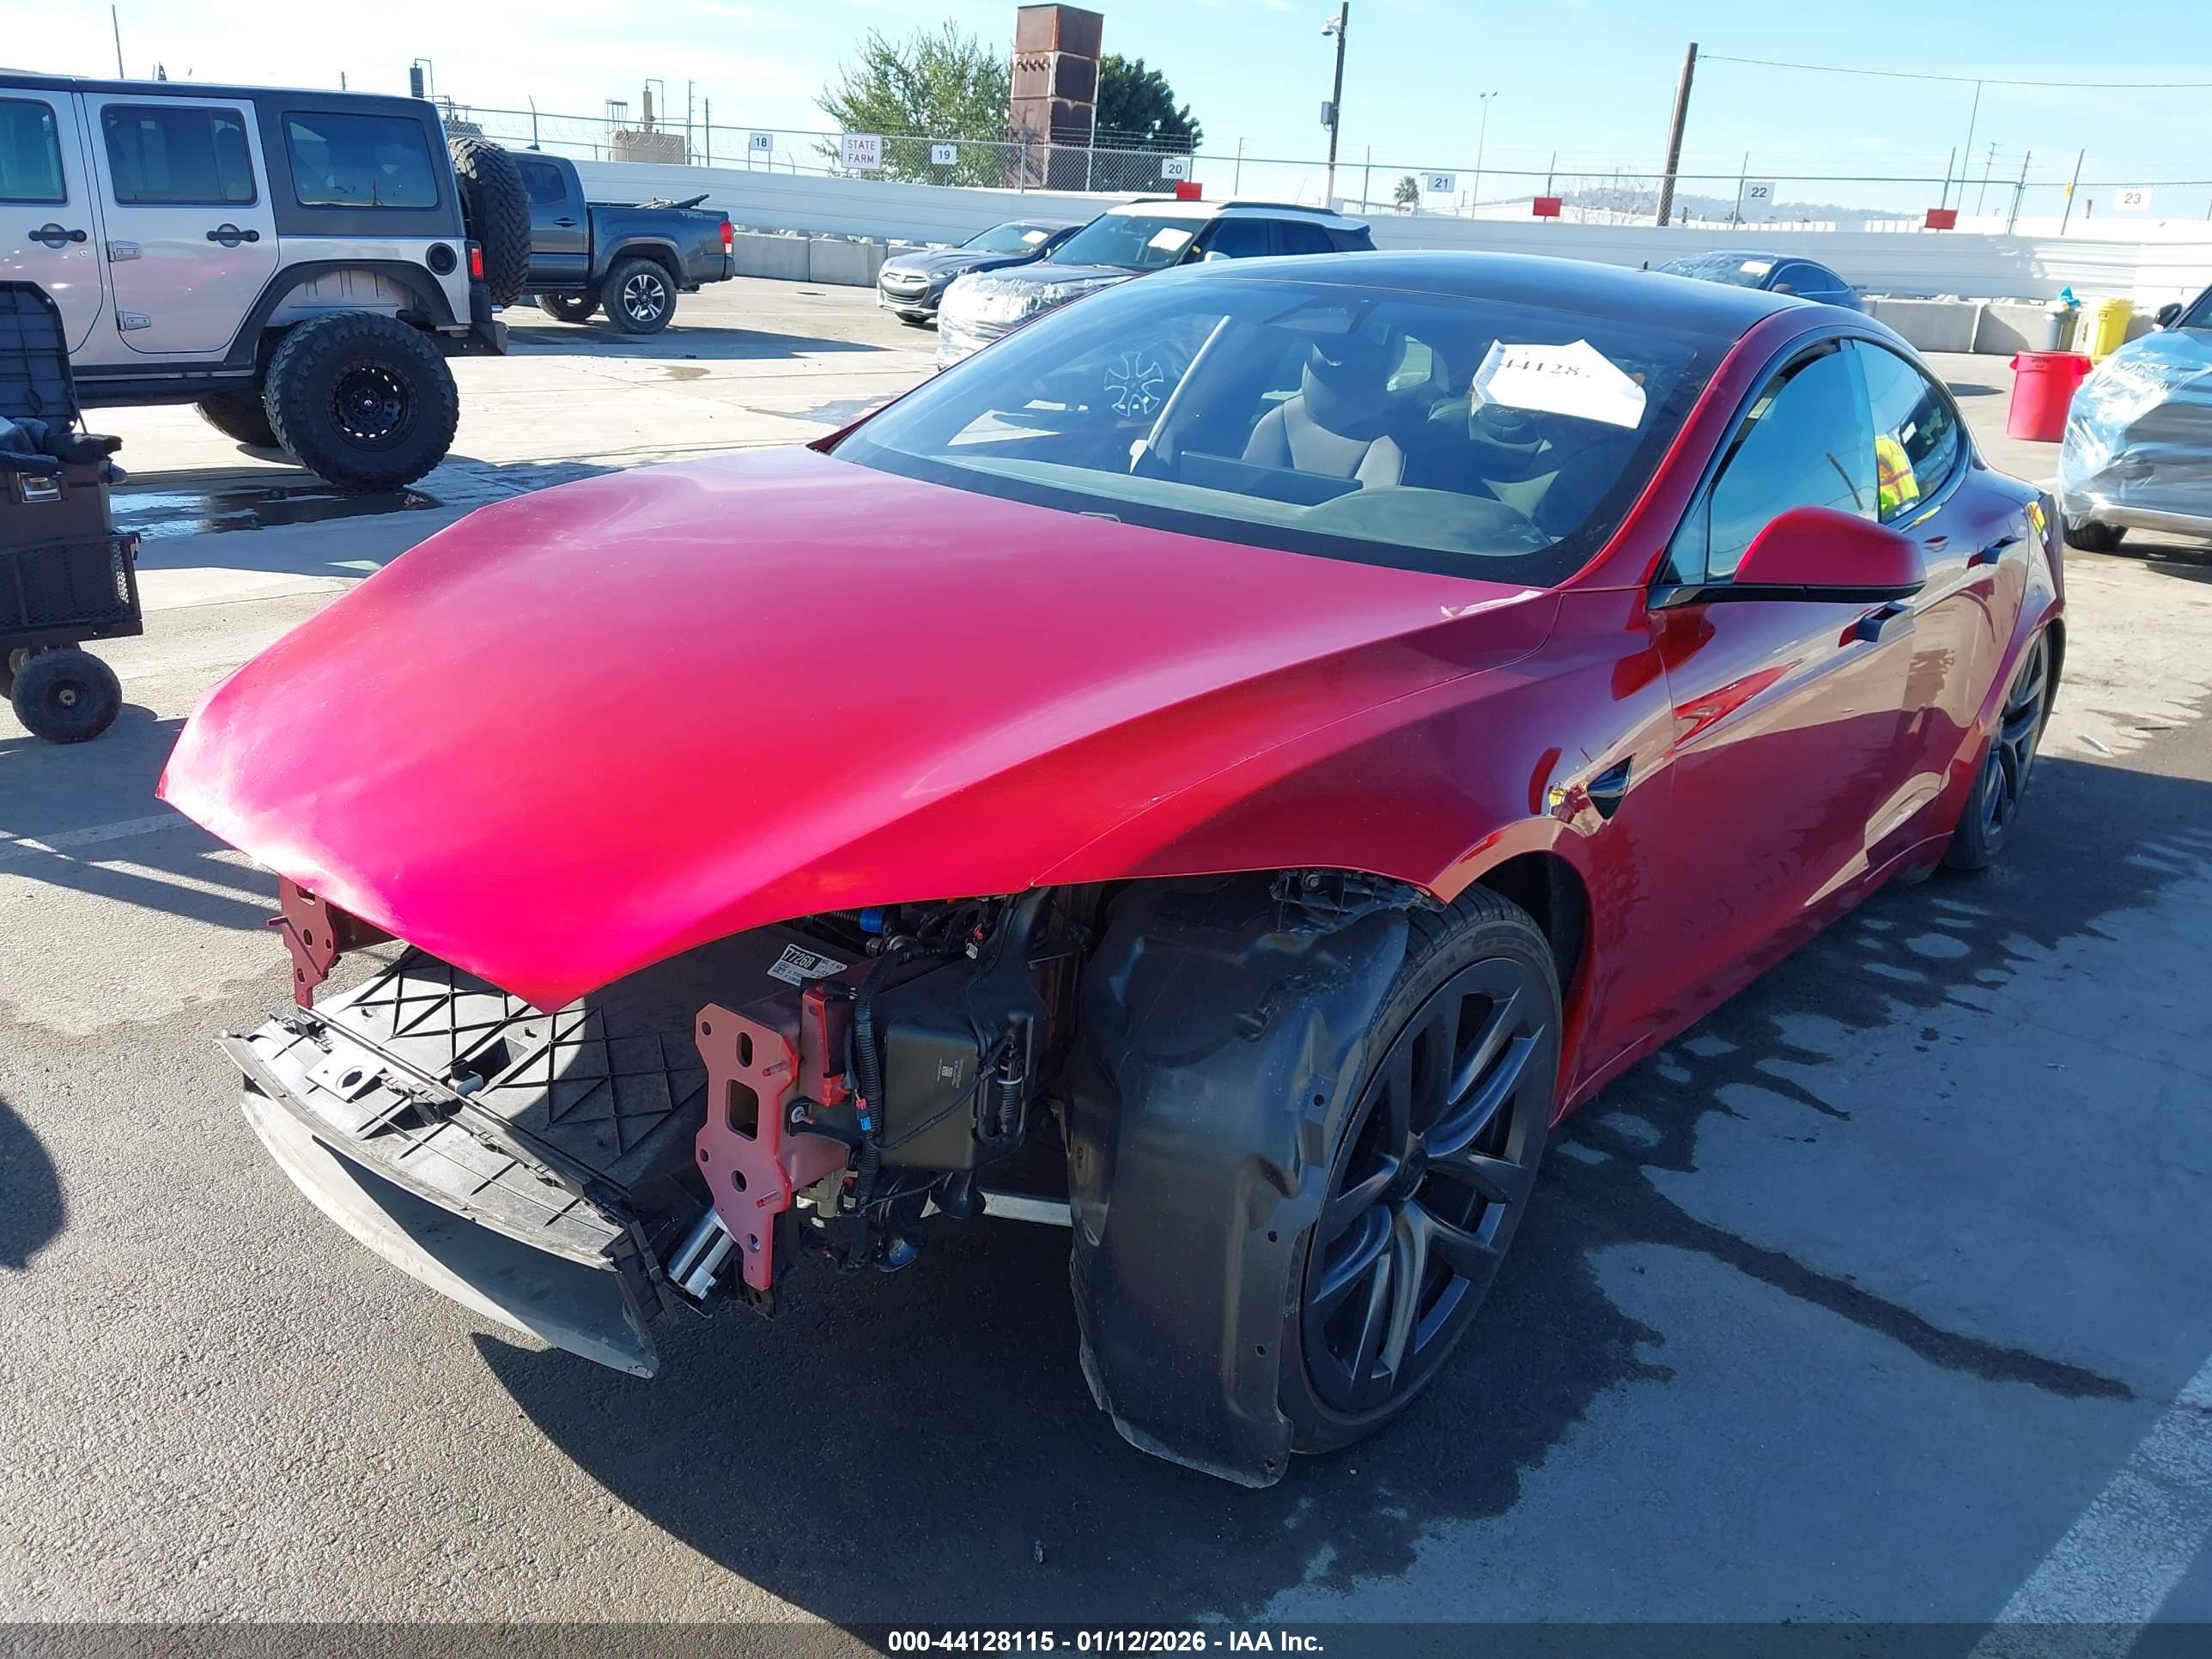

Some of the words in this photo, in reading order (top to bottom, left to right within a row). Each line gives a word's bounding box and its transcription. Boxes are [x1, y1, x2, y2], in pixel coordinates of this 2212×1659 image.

[755, 137, 767, 148] 18
[847, 139, 877, 150] STATE
[848, 153, 874, 164] FARM
[938, 149, 951, 160] 19
[1168, 163, 1182, 174] 20
[1435, 177, 1449, 188] 21
[1751, 186, 1767, 198] 22
[2124, 192, 2142, 204] 23
[783, 947, 816, 969] 77268
